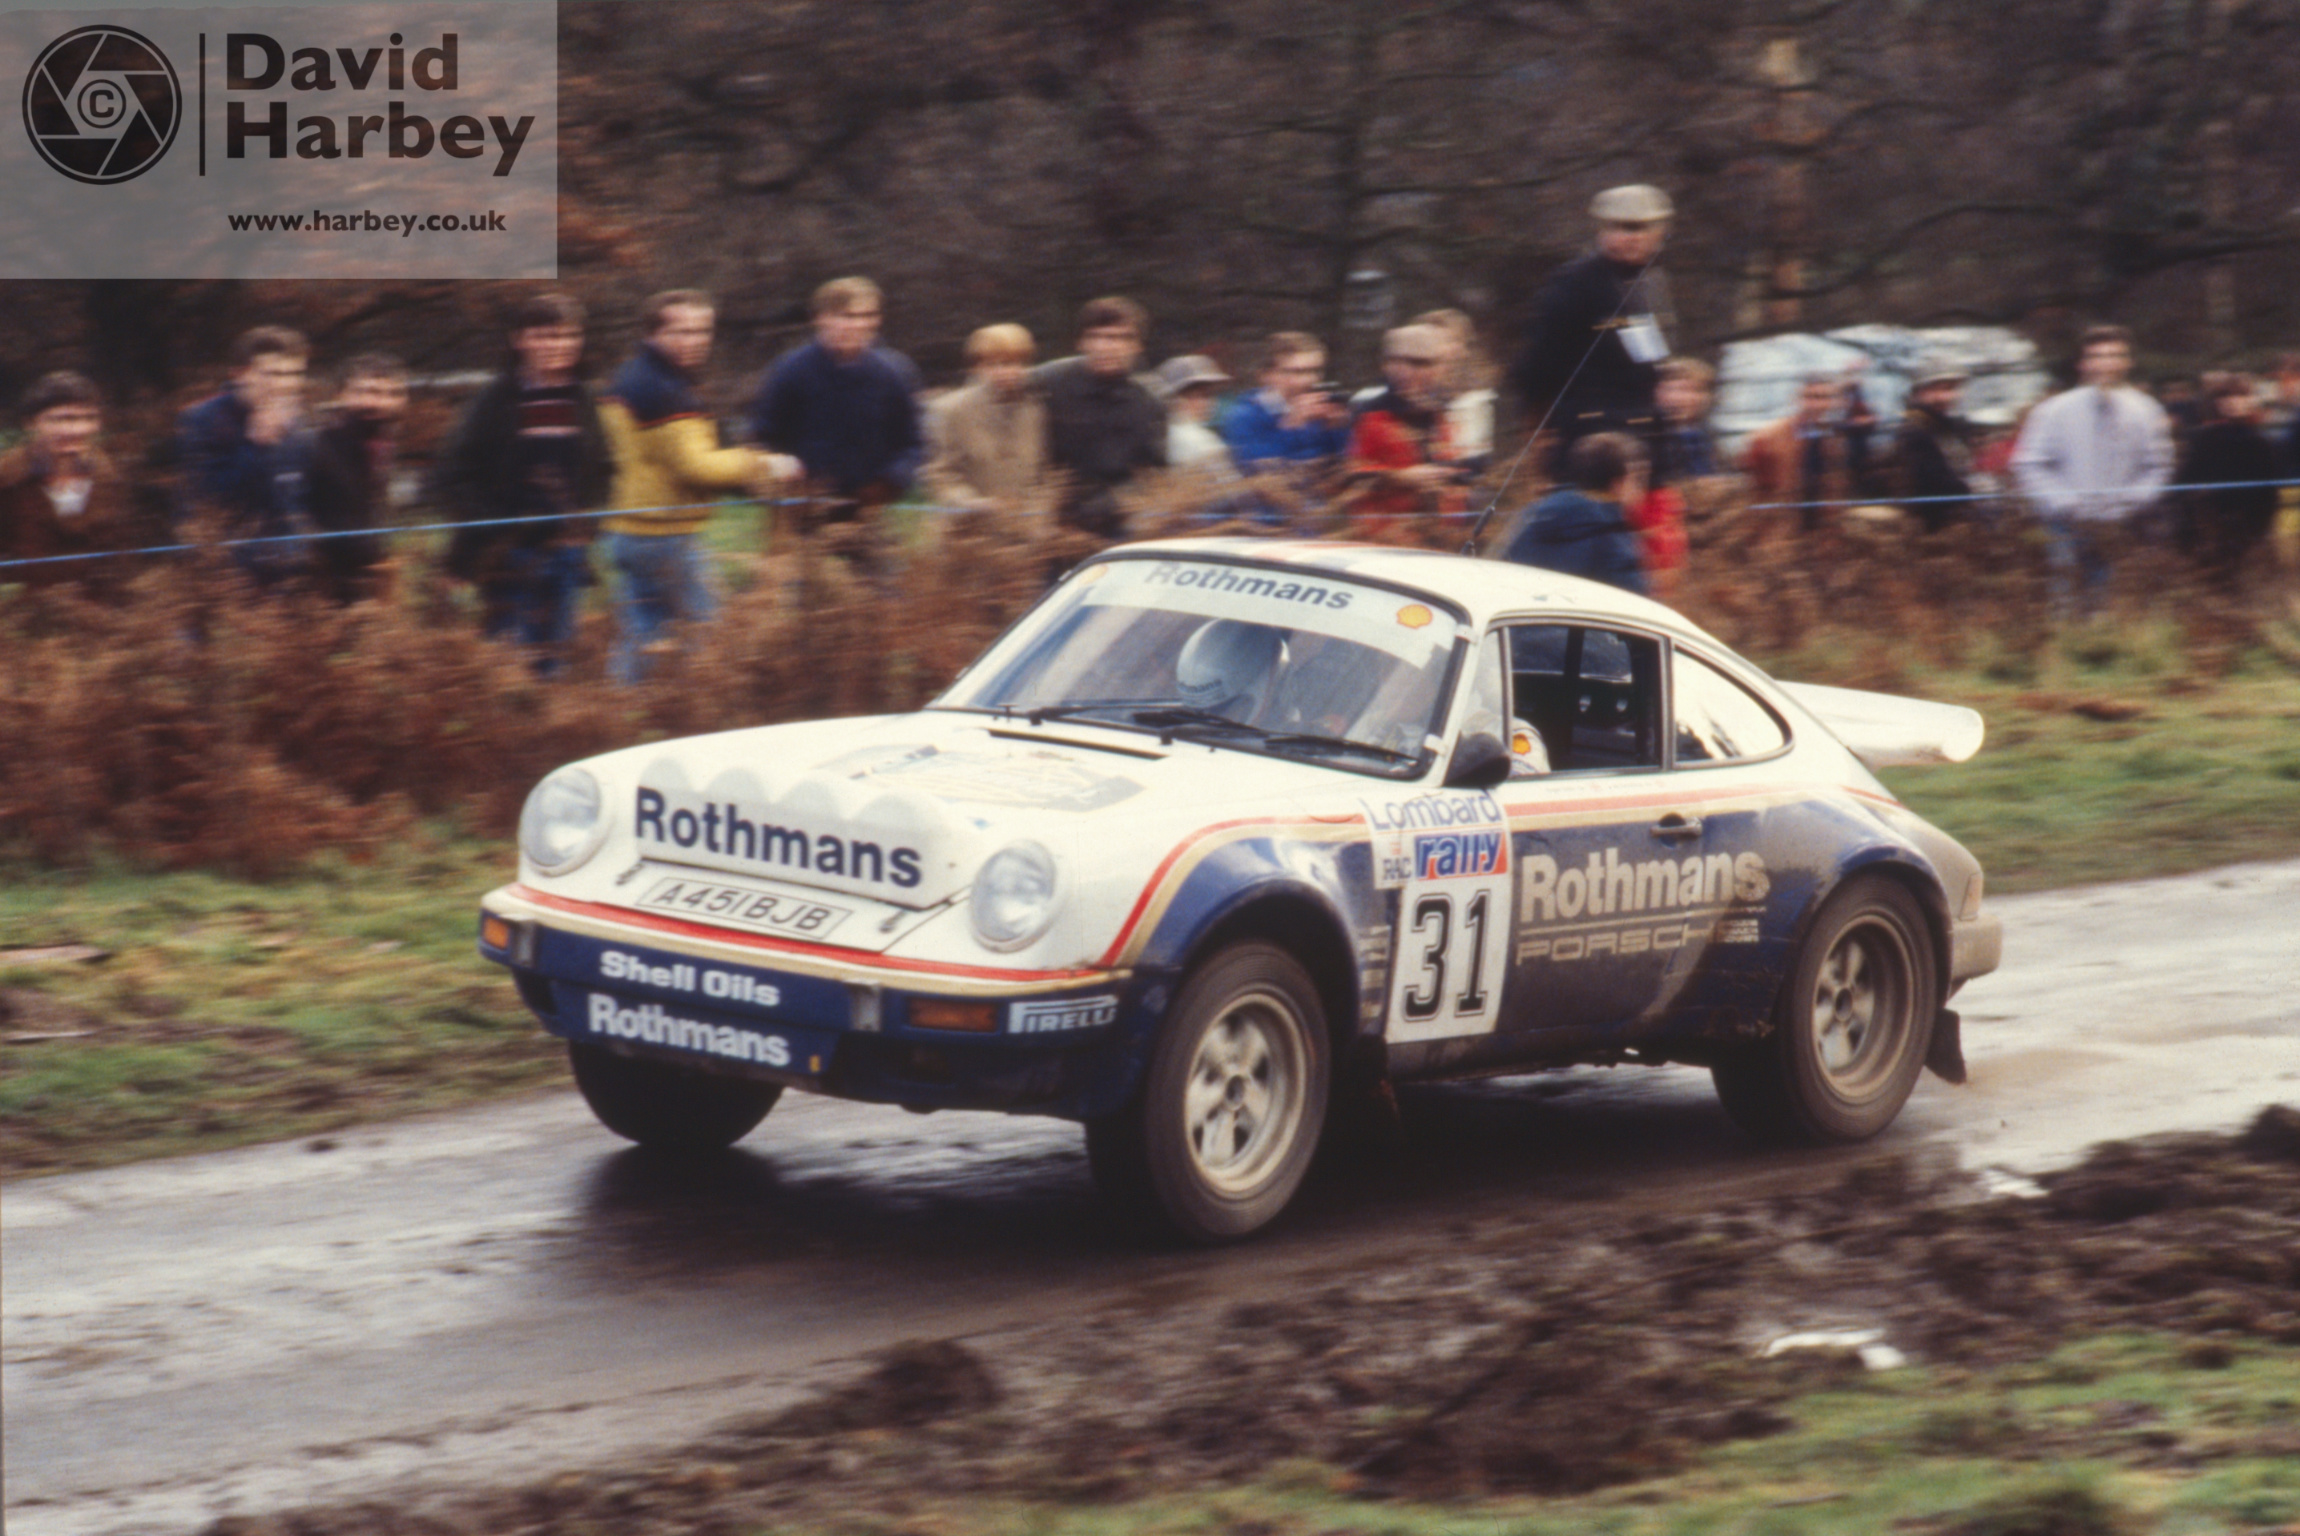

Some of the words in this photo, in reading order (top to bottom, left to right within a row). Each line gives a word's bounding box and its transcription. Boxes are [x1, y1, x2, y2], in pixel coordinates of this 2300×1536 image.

[1145, 561, 1354, 610] Rothmans
[635, 786, 922, 888] Rothmans
[1357, 788, 1503, 830] Lombard
[1417, 834, 1501, 878] rally
[1519, 847, 1771, 923] Rothmans
[600, 949, 696, 992] Shell
[702, 969, 781, 1007] Oils
[1403, 888, 1492, 1024] 31
[588, 992, 791, 1067] Rothmans
[1008, 994, 1119, 1034] PIRELLI
